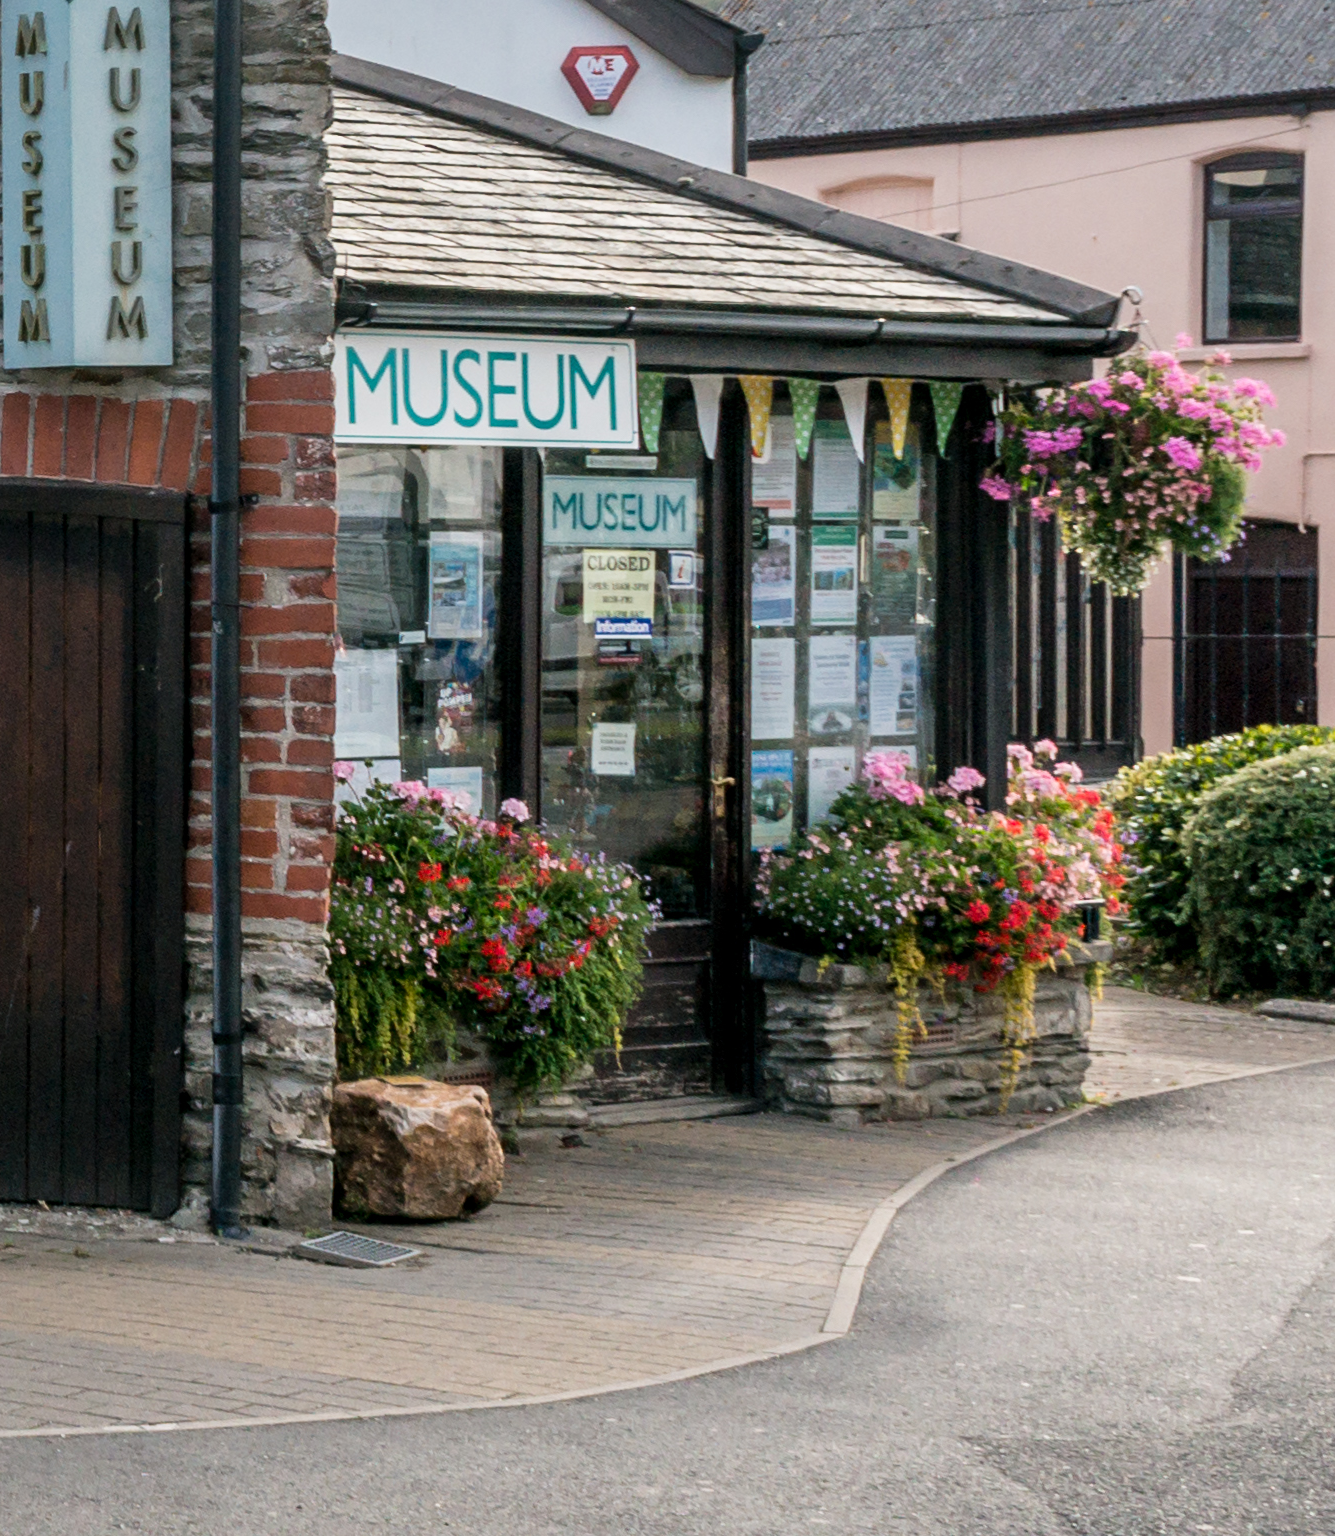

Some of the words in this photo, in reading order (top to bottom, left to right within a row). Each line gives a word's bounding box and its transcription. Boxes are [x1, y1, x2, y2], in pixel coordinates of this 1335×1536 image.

[15, 11, 51, 343] MUSEUM
[104, 6, 149, 340] MUSEUM
[346, 346, 617, 430] MUSEUM
[552, 492, 686, 532] MUSEUM
[587, 555, 650, 571] CLOSED
[596, 619, 650, 633] Information
